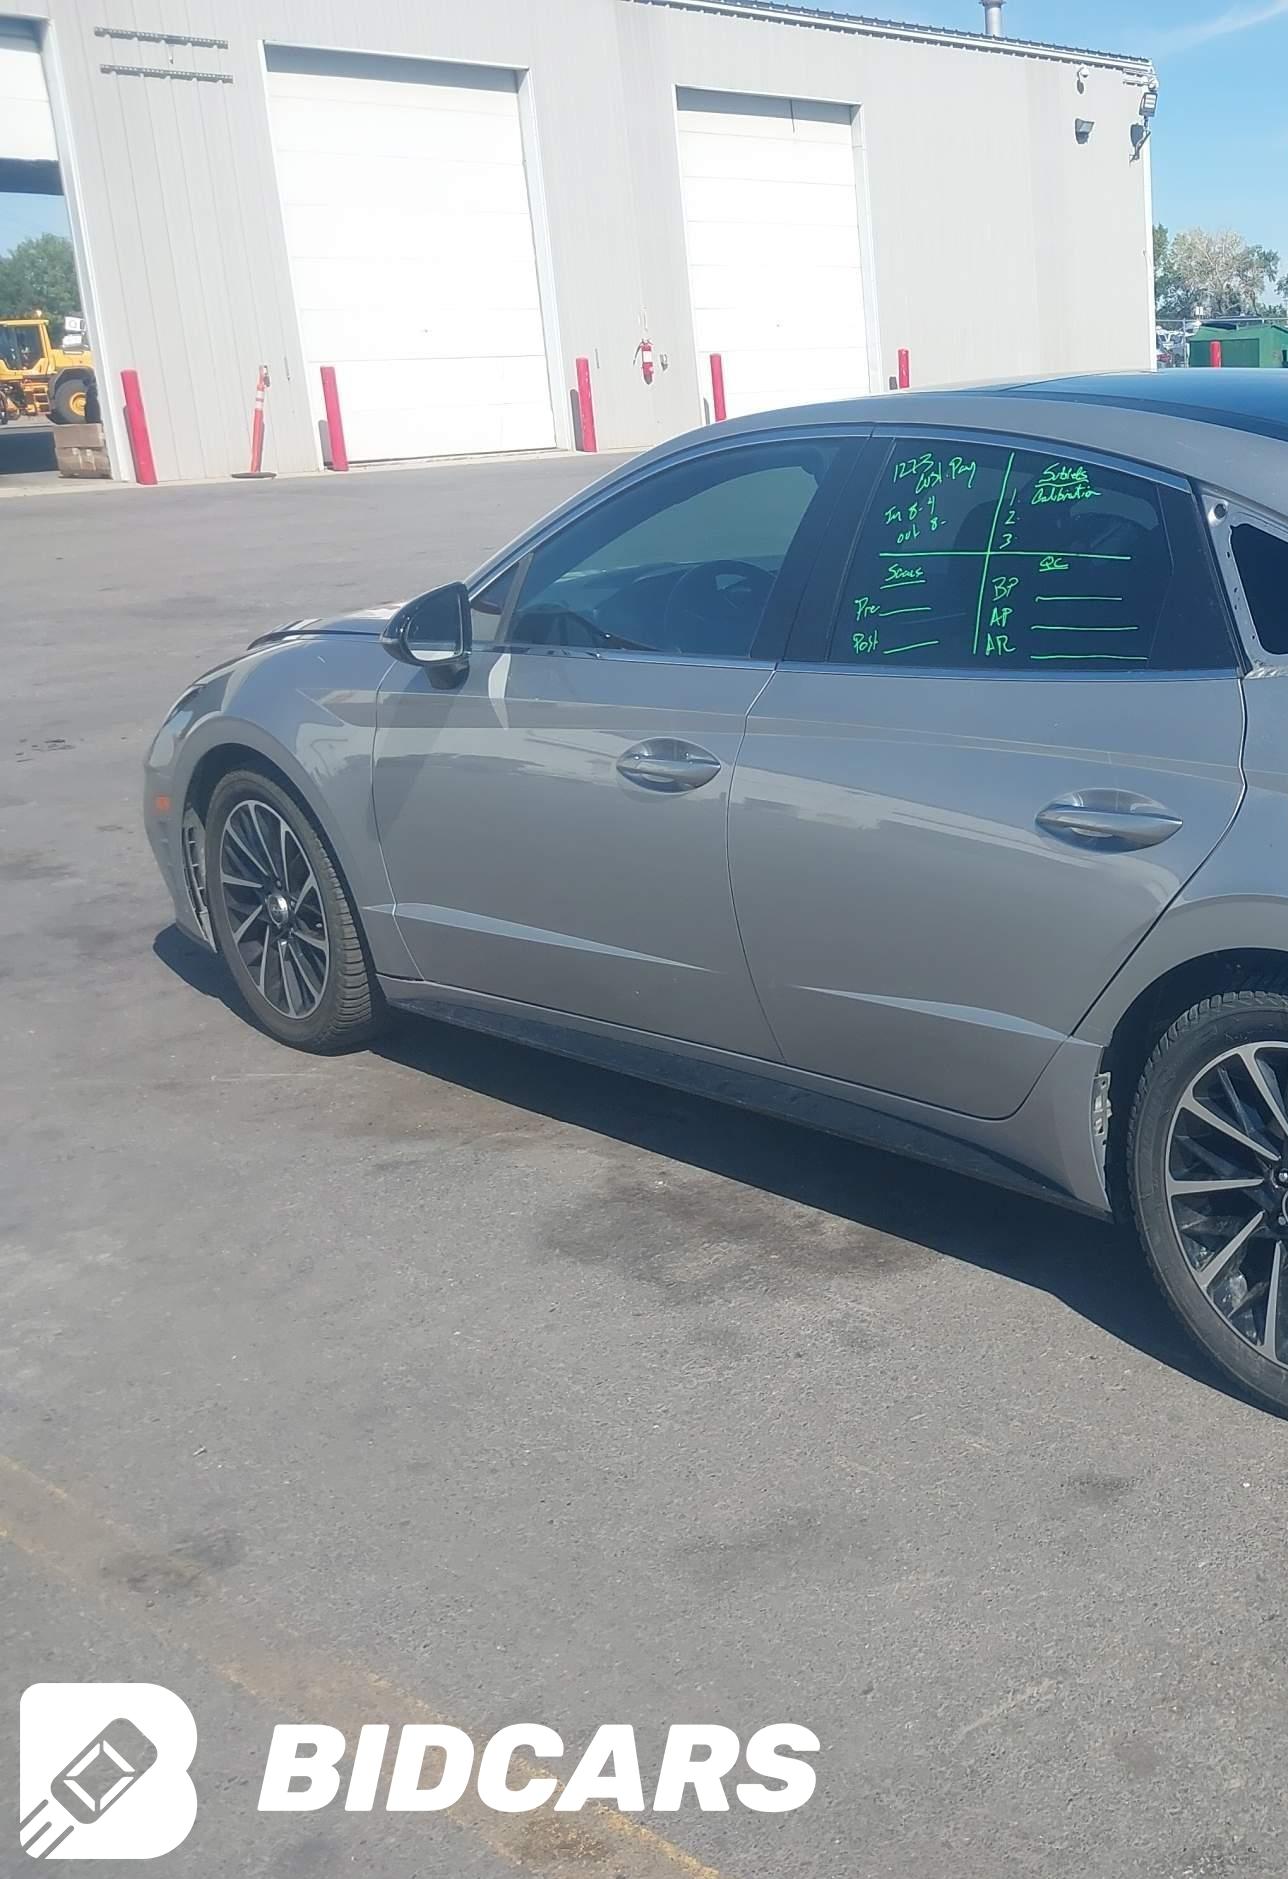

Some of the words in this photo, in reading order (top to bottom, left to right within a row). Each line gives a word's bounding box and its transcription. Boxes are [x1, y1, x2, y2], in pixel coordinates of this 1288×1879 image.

[948, 457, 976, 489] Pay
[1040, 556, 1069, 571] QC
[991, 576, 1019, 601] BP
[989, 607, 1013, 627] AP
[853, 629, 879, 654] Post
[985, 633, 1016, 655] AR
